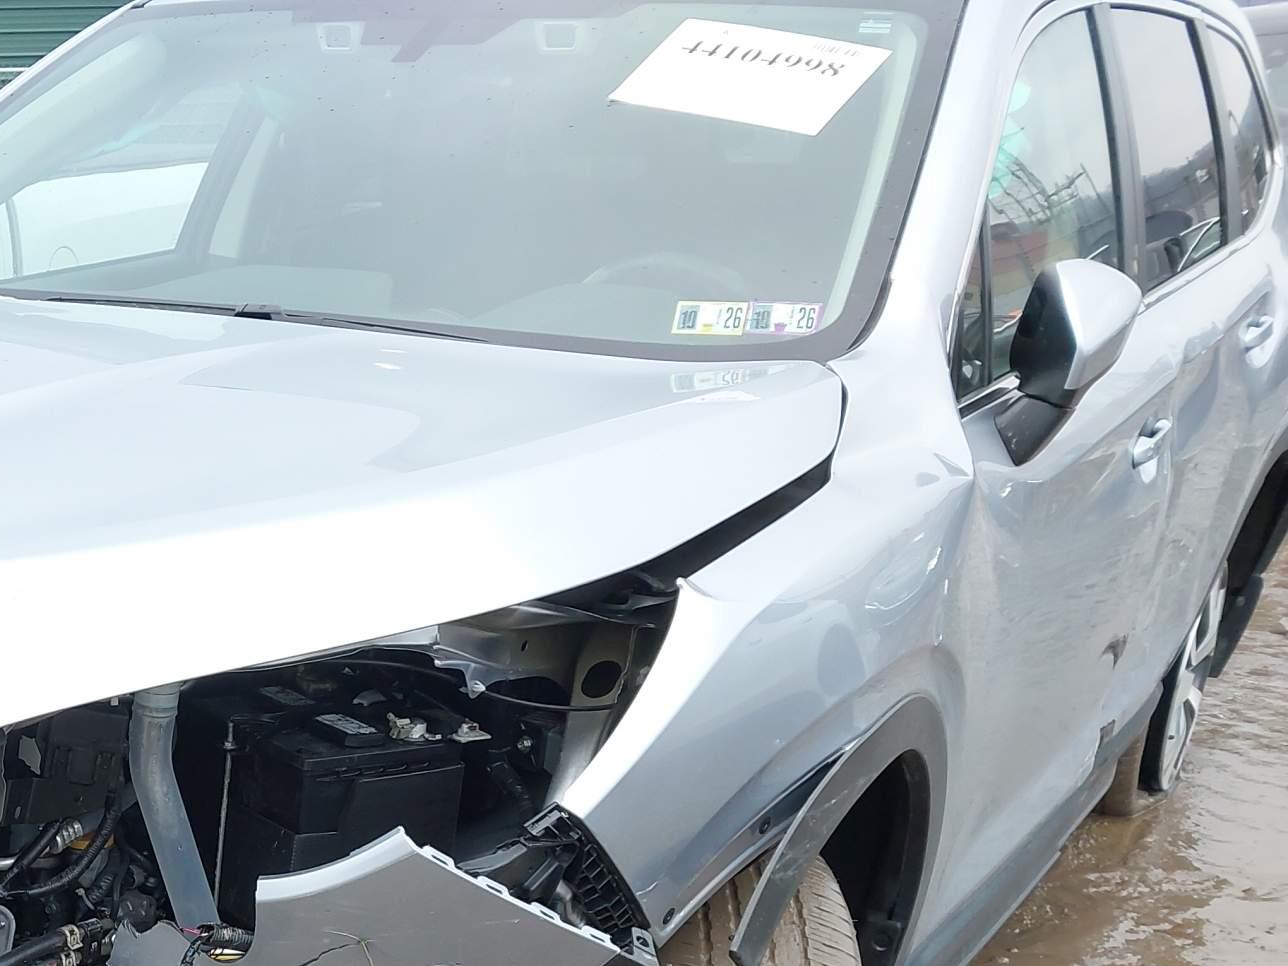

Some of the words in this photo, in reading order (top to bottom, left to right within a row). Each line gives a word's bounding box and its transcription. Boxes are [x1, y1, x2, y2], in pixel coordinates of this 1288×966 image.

[682, 40, 845, 77] 44104998
[723, 307, 743, 329] 26
[796, 307, 816, 329] 26
